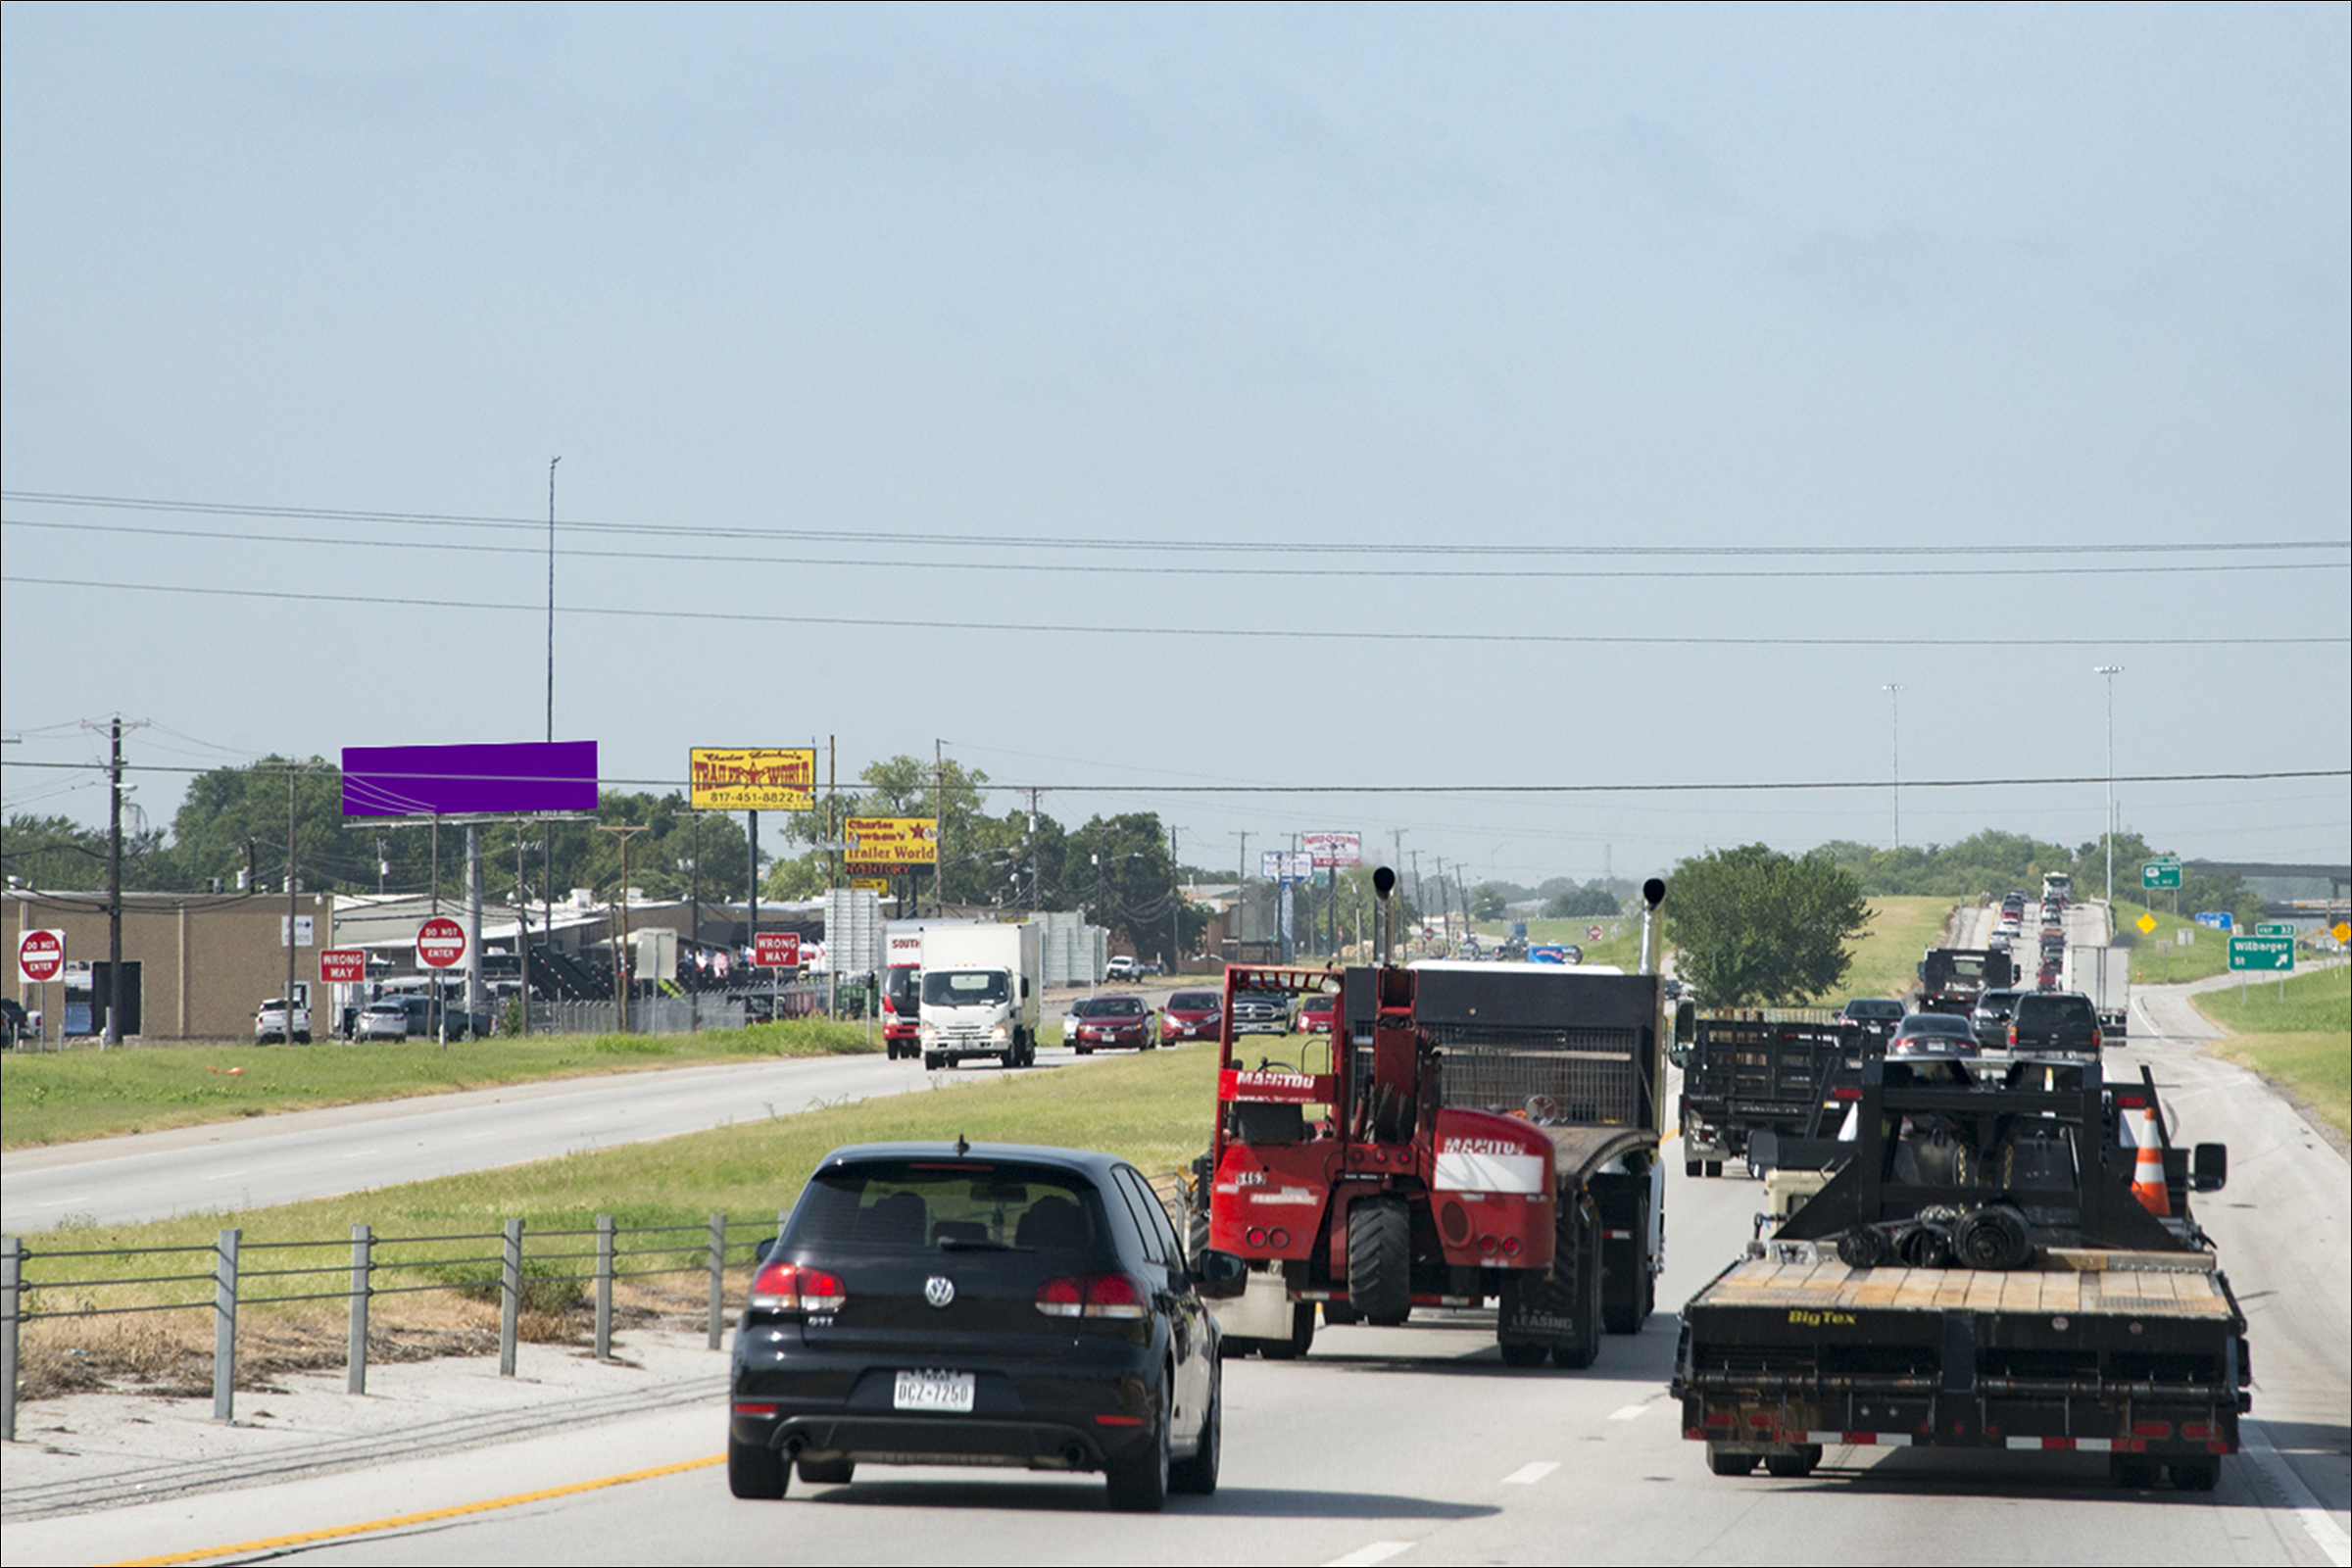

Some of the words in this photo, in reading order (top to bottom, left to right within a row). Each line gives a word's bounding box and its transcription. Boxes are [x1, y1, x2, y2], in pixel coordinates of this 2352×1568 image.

[694, 760, 743, 792] TRAILER
[765, 760, 809, 792] WORLD
[848, 819, 894, 829] Charles
[894, 846, 935, 858] World
[425, 927, 438, 937] DO
[441, 927, 458, 937] NOT
[26, 941, 38, 951] DO
[40, 940, 56, 950] NOT
[759, 938, 797, 950] WRONG
[2233, 941, 2288, 954] Wilbarger
[427, 949, 455, 958] ENTER
[764, 951, 790, 962] WAY
[322, 954, 363, 965] WRONG
[2234, 956, 2246, 966] St
[29, 962, 53, 972] ENTER
[330, 967, 354, 978] WAY
[1237, 1071, 1316, 1089] MANITOU
[808, 1316, 833, 1327] GTI
[1511, 1314, 1574, 1331] LEASING
